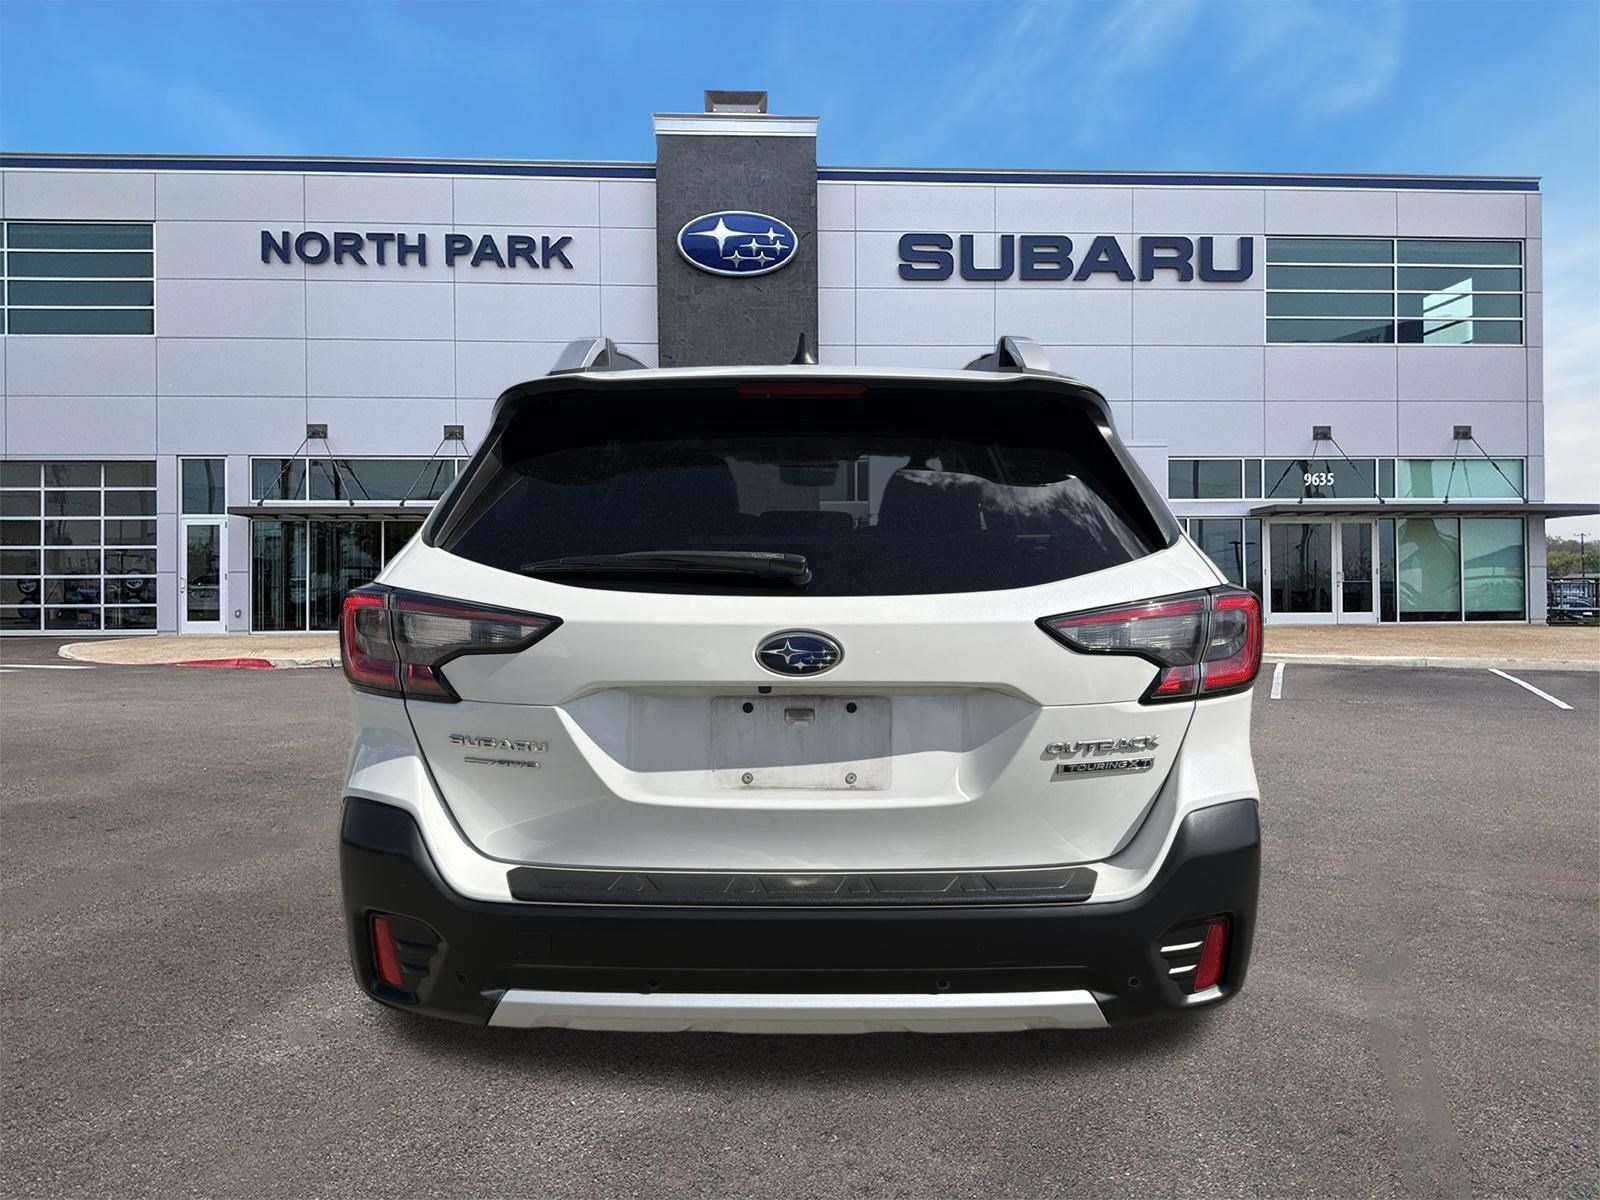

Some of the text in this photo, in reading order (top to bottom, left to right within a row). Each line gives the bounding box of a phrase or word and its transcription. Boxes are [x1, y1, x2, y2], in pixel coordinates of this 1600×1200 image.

[260, 230, 574, 269] NORTH PARK
[898, 233, 1254, 282] SUBARU
[1303, 472, 1335, 486] 9635
[448, 733, 549, 752] SUBARU
[1046, 735, 1160, 756] OUTBACK
[1069, 760, 1127, 773] TOURING
